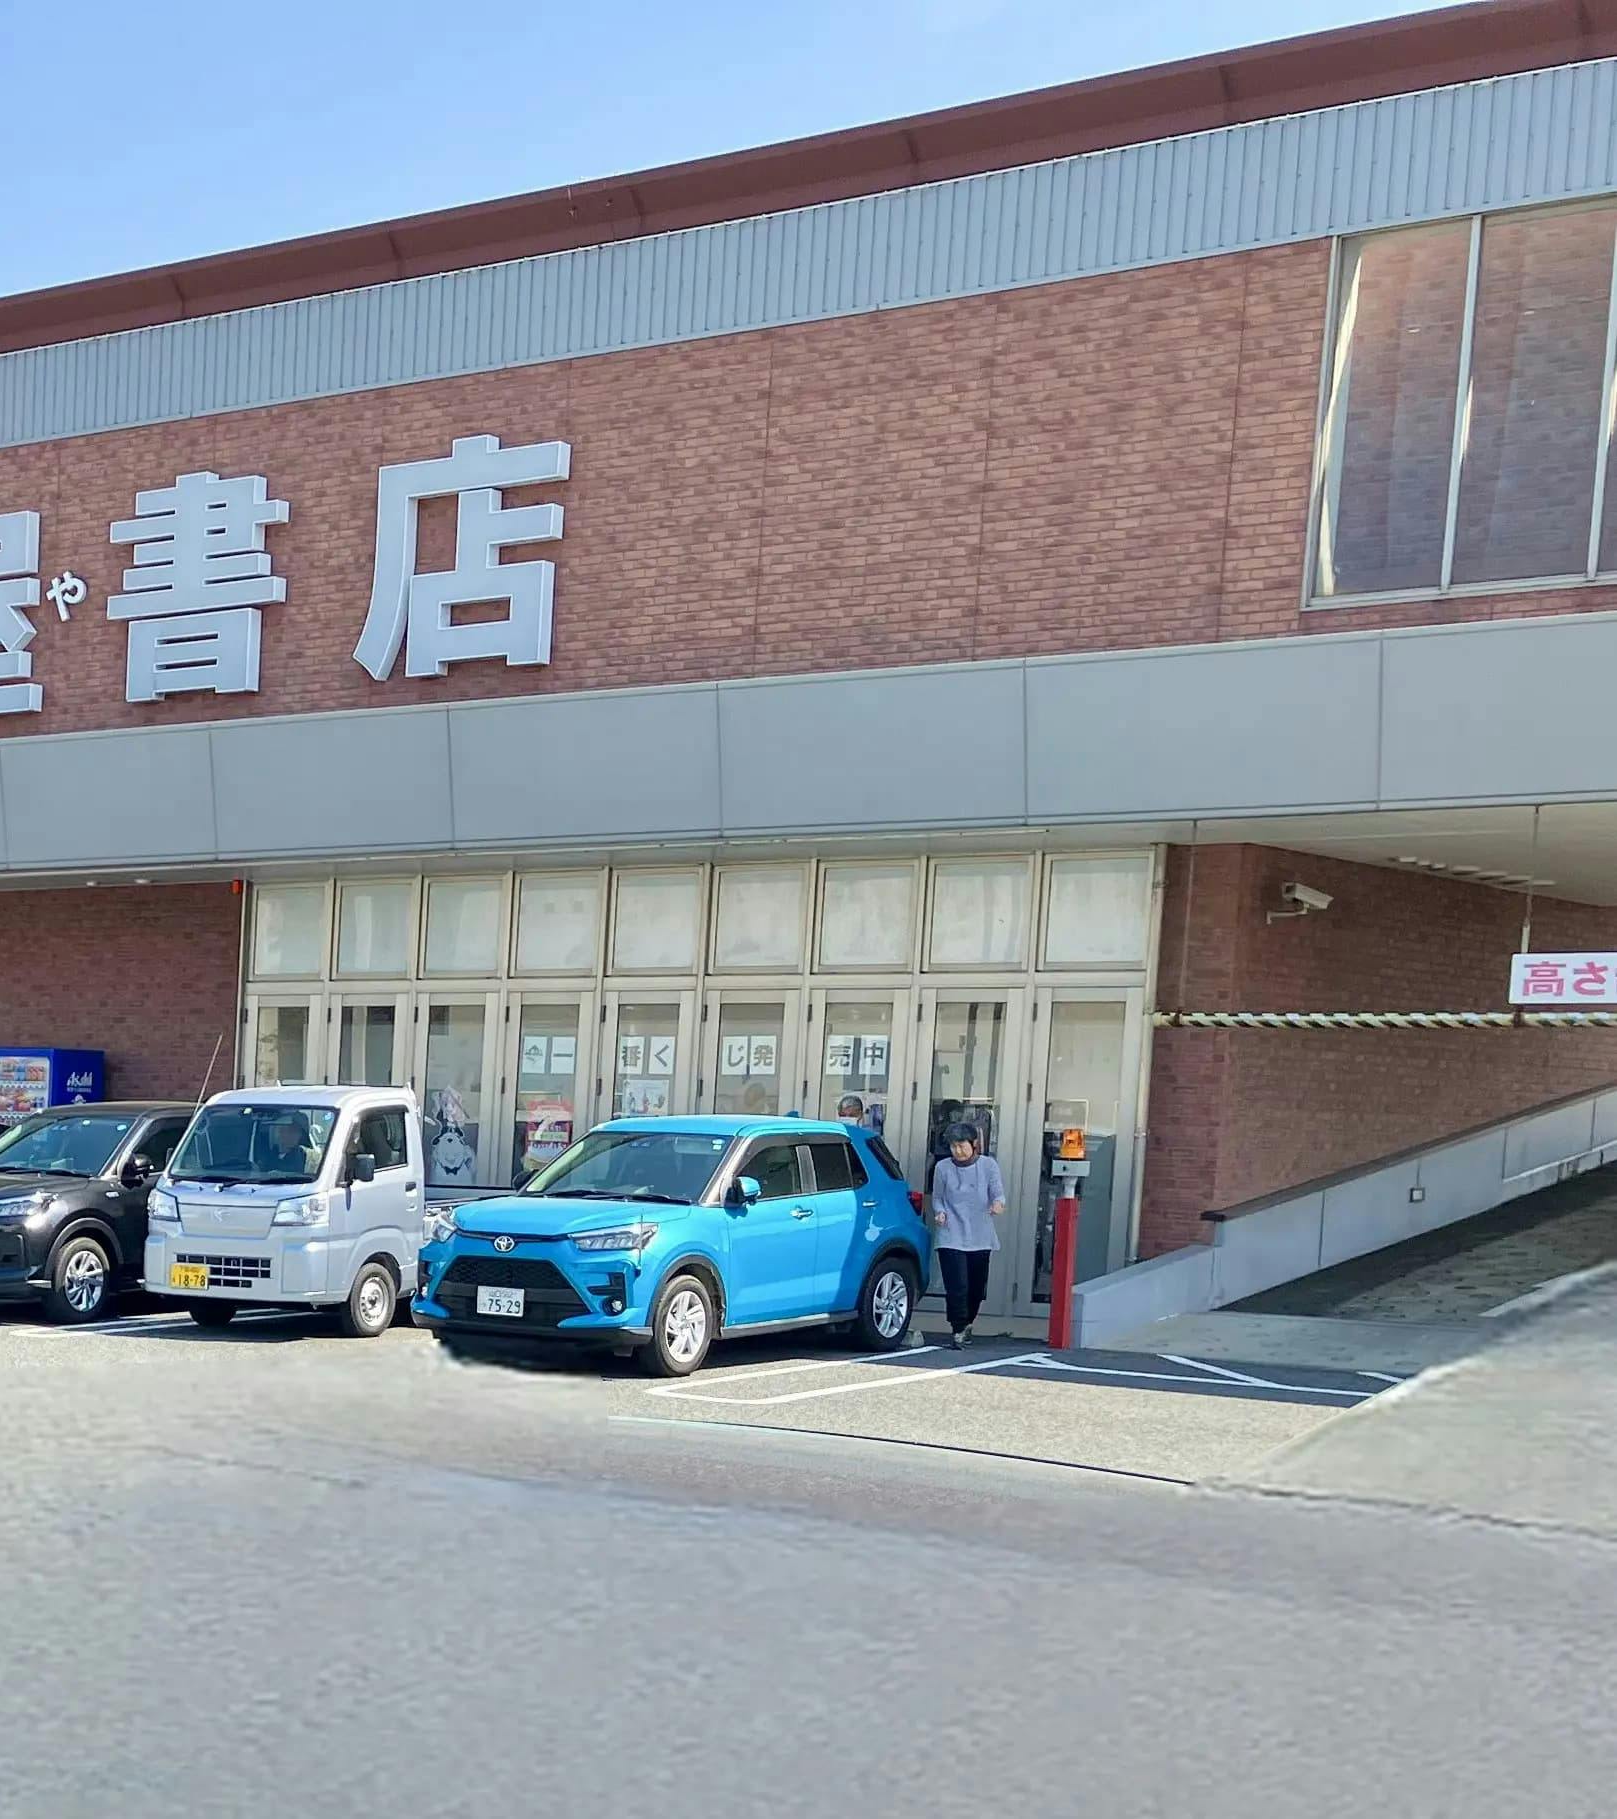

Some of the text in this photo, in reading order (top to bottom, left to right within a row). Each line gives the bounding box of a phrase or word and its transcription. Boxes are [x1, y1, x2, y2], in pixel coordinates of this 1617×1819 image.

[1522, 961, 1617, 996] 高さ
[178, 1274, 206, 1287] 18-78
[488, 1298, 521, 1314] 75-29
